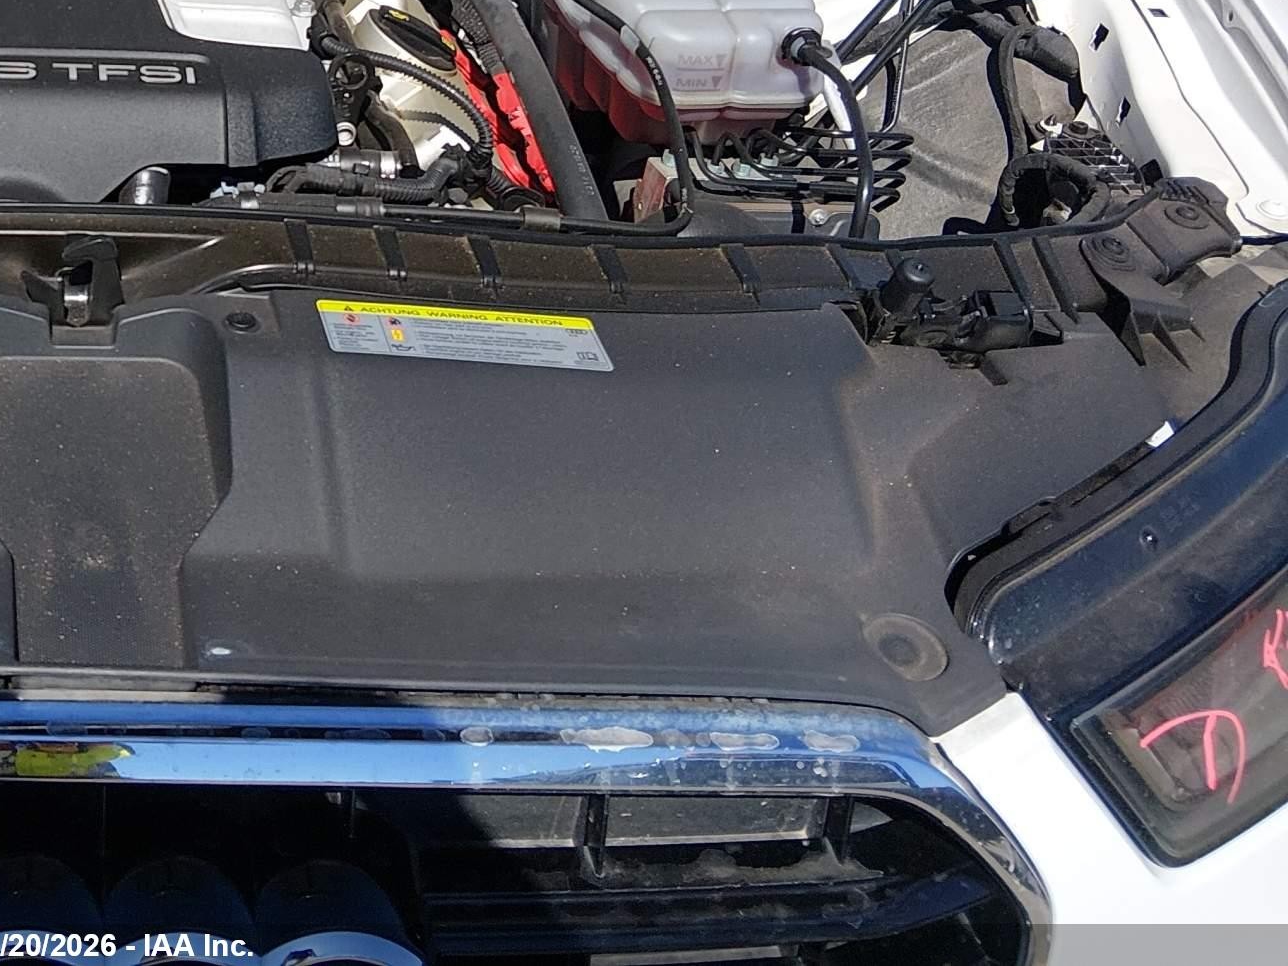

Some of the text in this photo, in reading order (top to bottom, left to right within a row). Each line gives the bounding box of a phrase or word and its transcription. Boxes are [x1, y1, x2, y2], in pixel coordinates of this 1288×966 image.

[678, 53, 712, 66] MAX
[52, 63, 196, 84] TFSI
[676, 77, 706, 88] MIN
[360, 306, 563, 326] ACHTUNG WARNING ATTENTION
